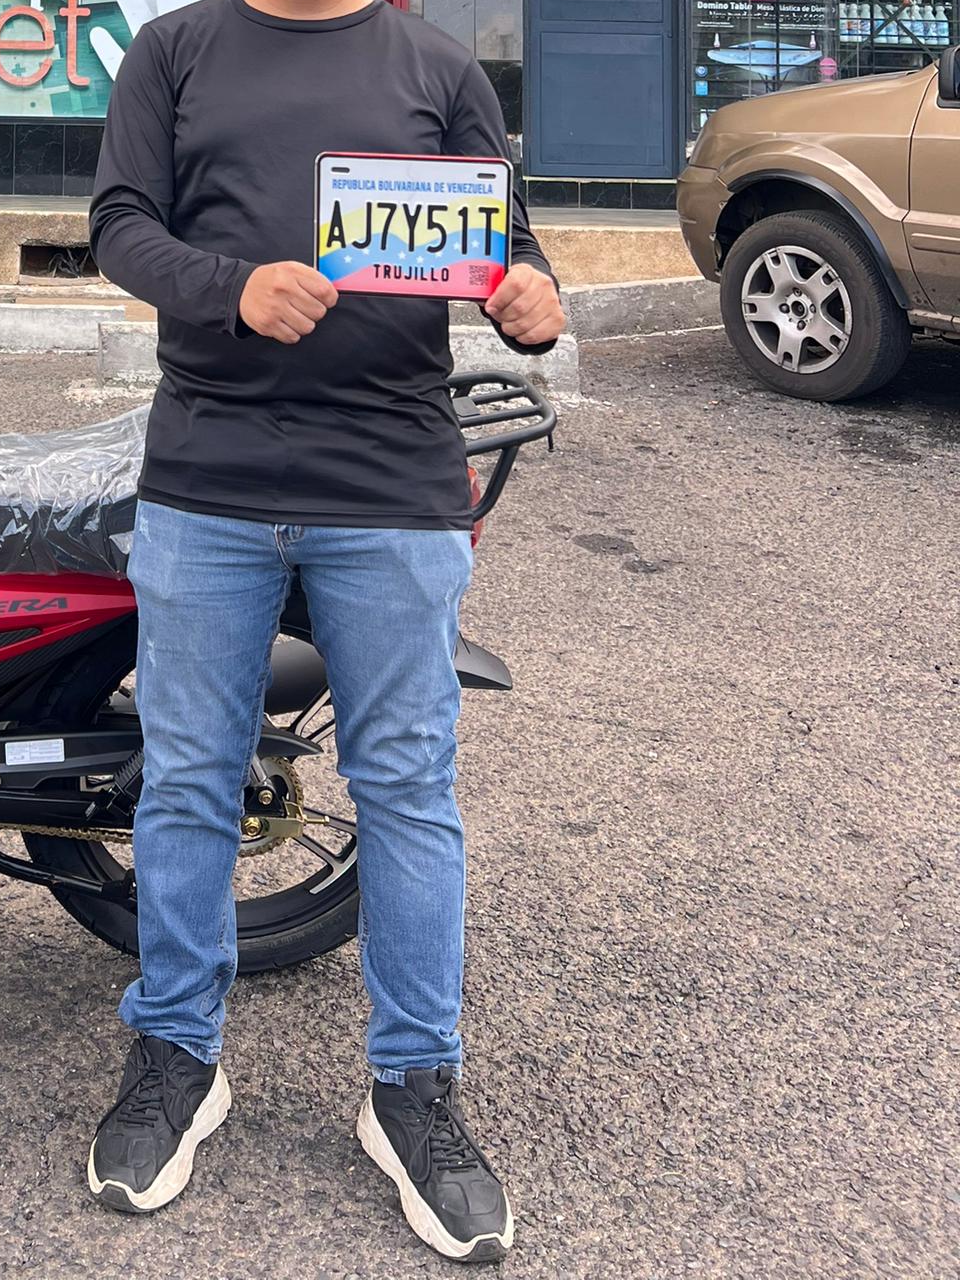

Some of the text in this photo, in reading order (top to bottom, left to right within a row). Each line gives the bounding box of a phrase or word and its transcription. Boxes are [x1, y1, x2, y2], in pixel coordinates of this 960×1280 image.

[697, 1, 729, 10] Domino
[332, 178, 494, 194] REPUBLICA BOLIVARIANA DE VENEZUELA
[326, 200, 500, 256] AJ7Y51T
[373, 264, 450, 282] TRUJILLO
